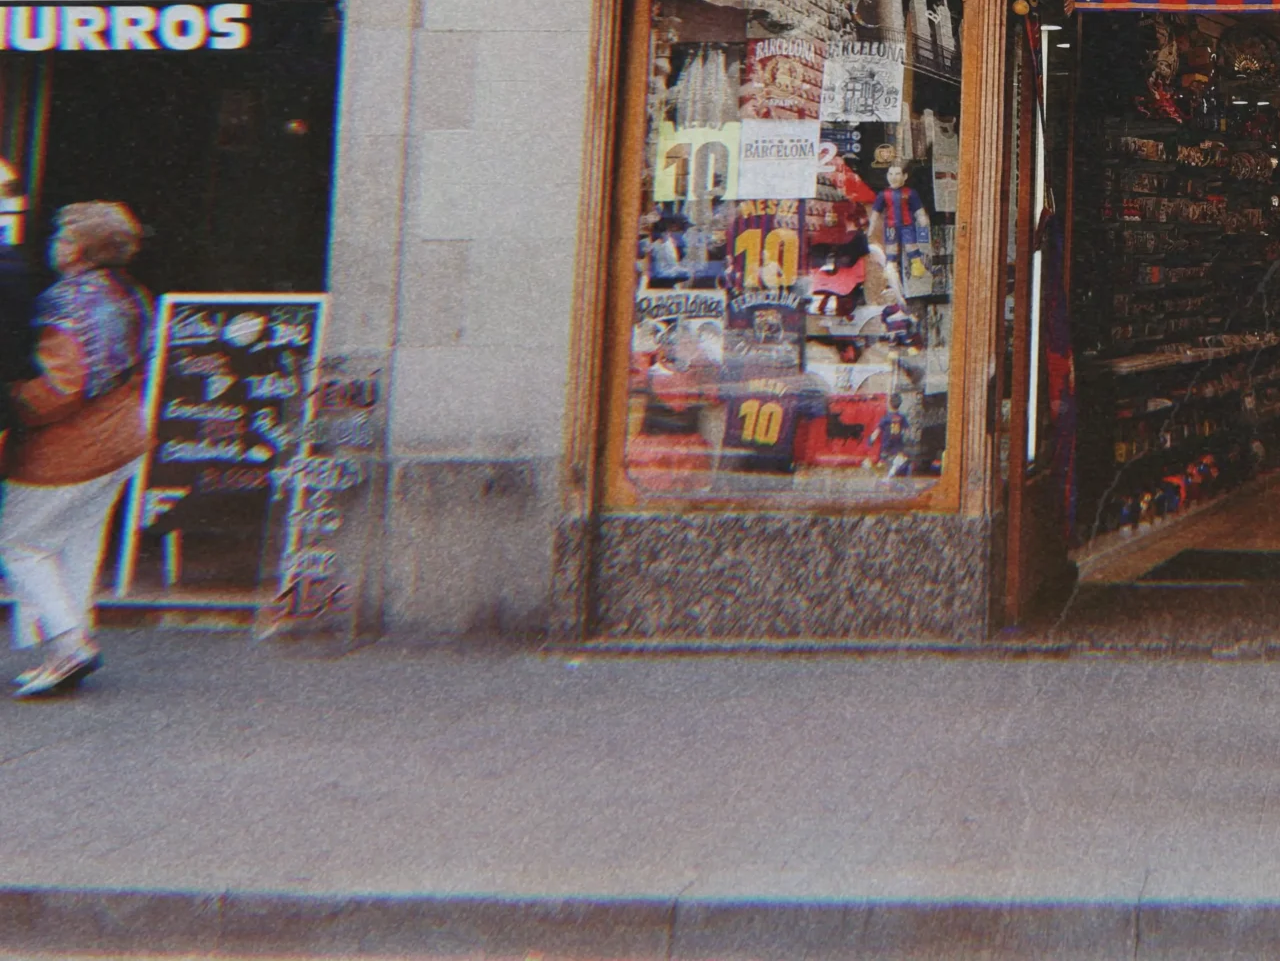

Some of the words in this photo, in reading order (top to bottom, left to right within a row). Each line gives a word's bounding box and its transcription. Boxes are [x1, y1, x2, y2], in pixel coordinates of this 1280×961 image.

[0, 3, 252, 51] URROS
[755, 38, 816, 62] BARCELONA
[884, 97, 898, 108] 92
[662, 141, 730, 200] 10
[743, 142, 816, 158] BARCELONA
[734, 229, 800, 288] 10
[738, 398, 784, 447] 10
